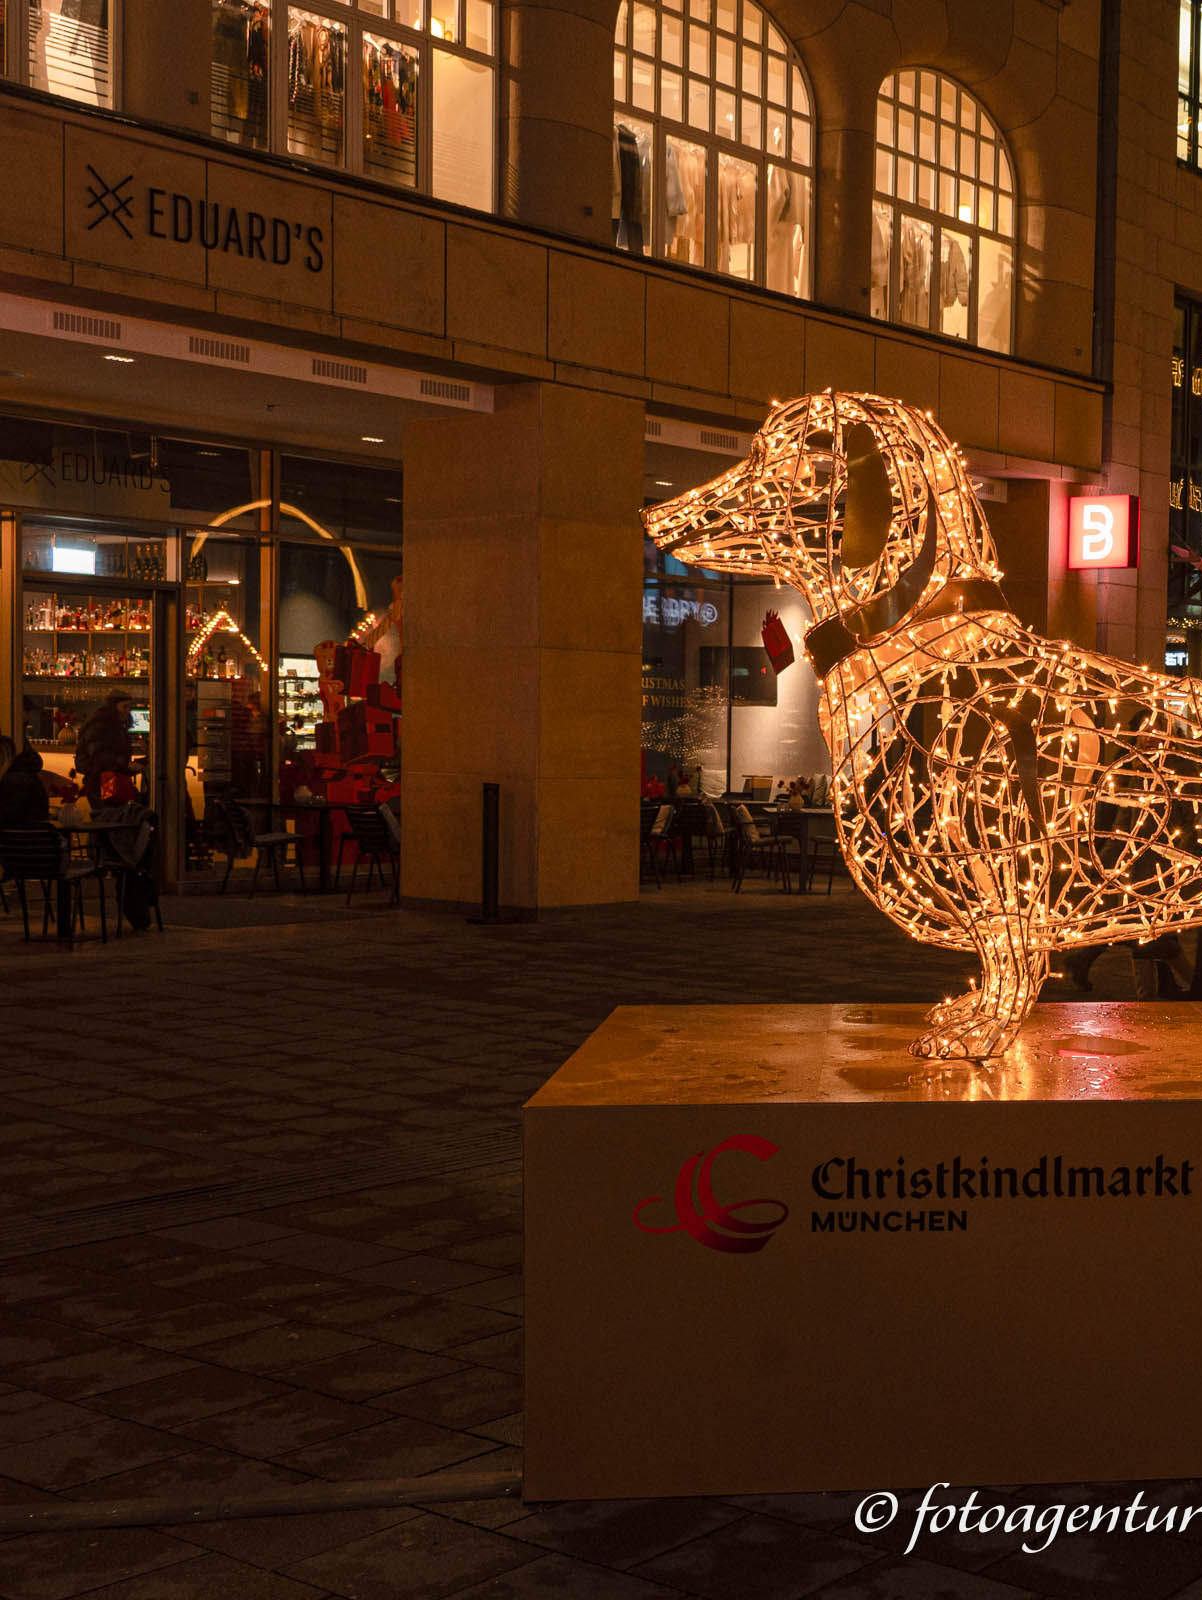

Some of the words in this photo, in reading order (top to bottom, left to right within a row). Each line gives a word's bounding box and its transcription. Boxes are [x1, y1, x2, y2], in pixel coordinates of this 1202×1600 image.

[148, 187, 323, 273] EDUARD'S
[811, 1154, 1194, 1200] Christkindlmarkt
[811, 1210, 968, 1233] MÜNCHEN
